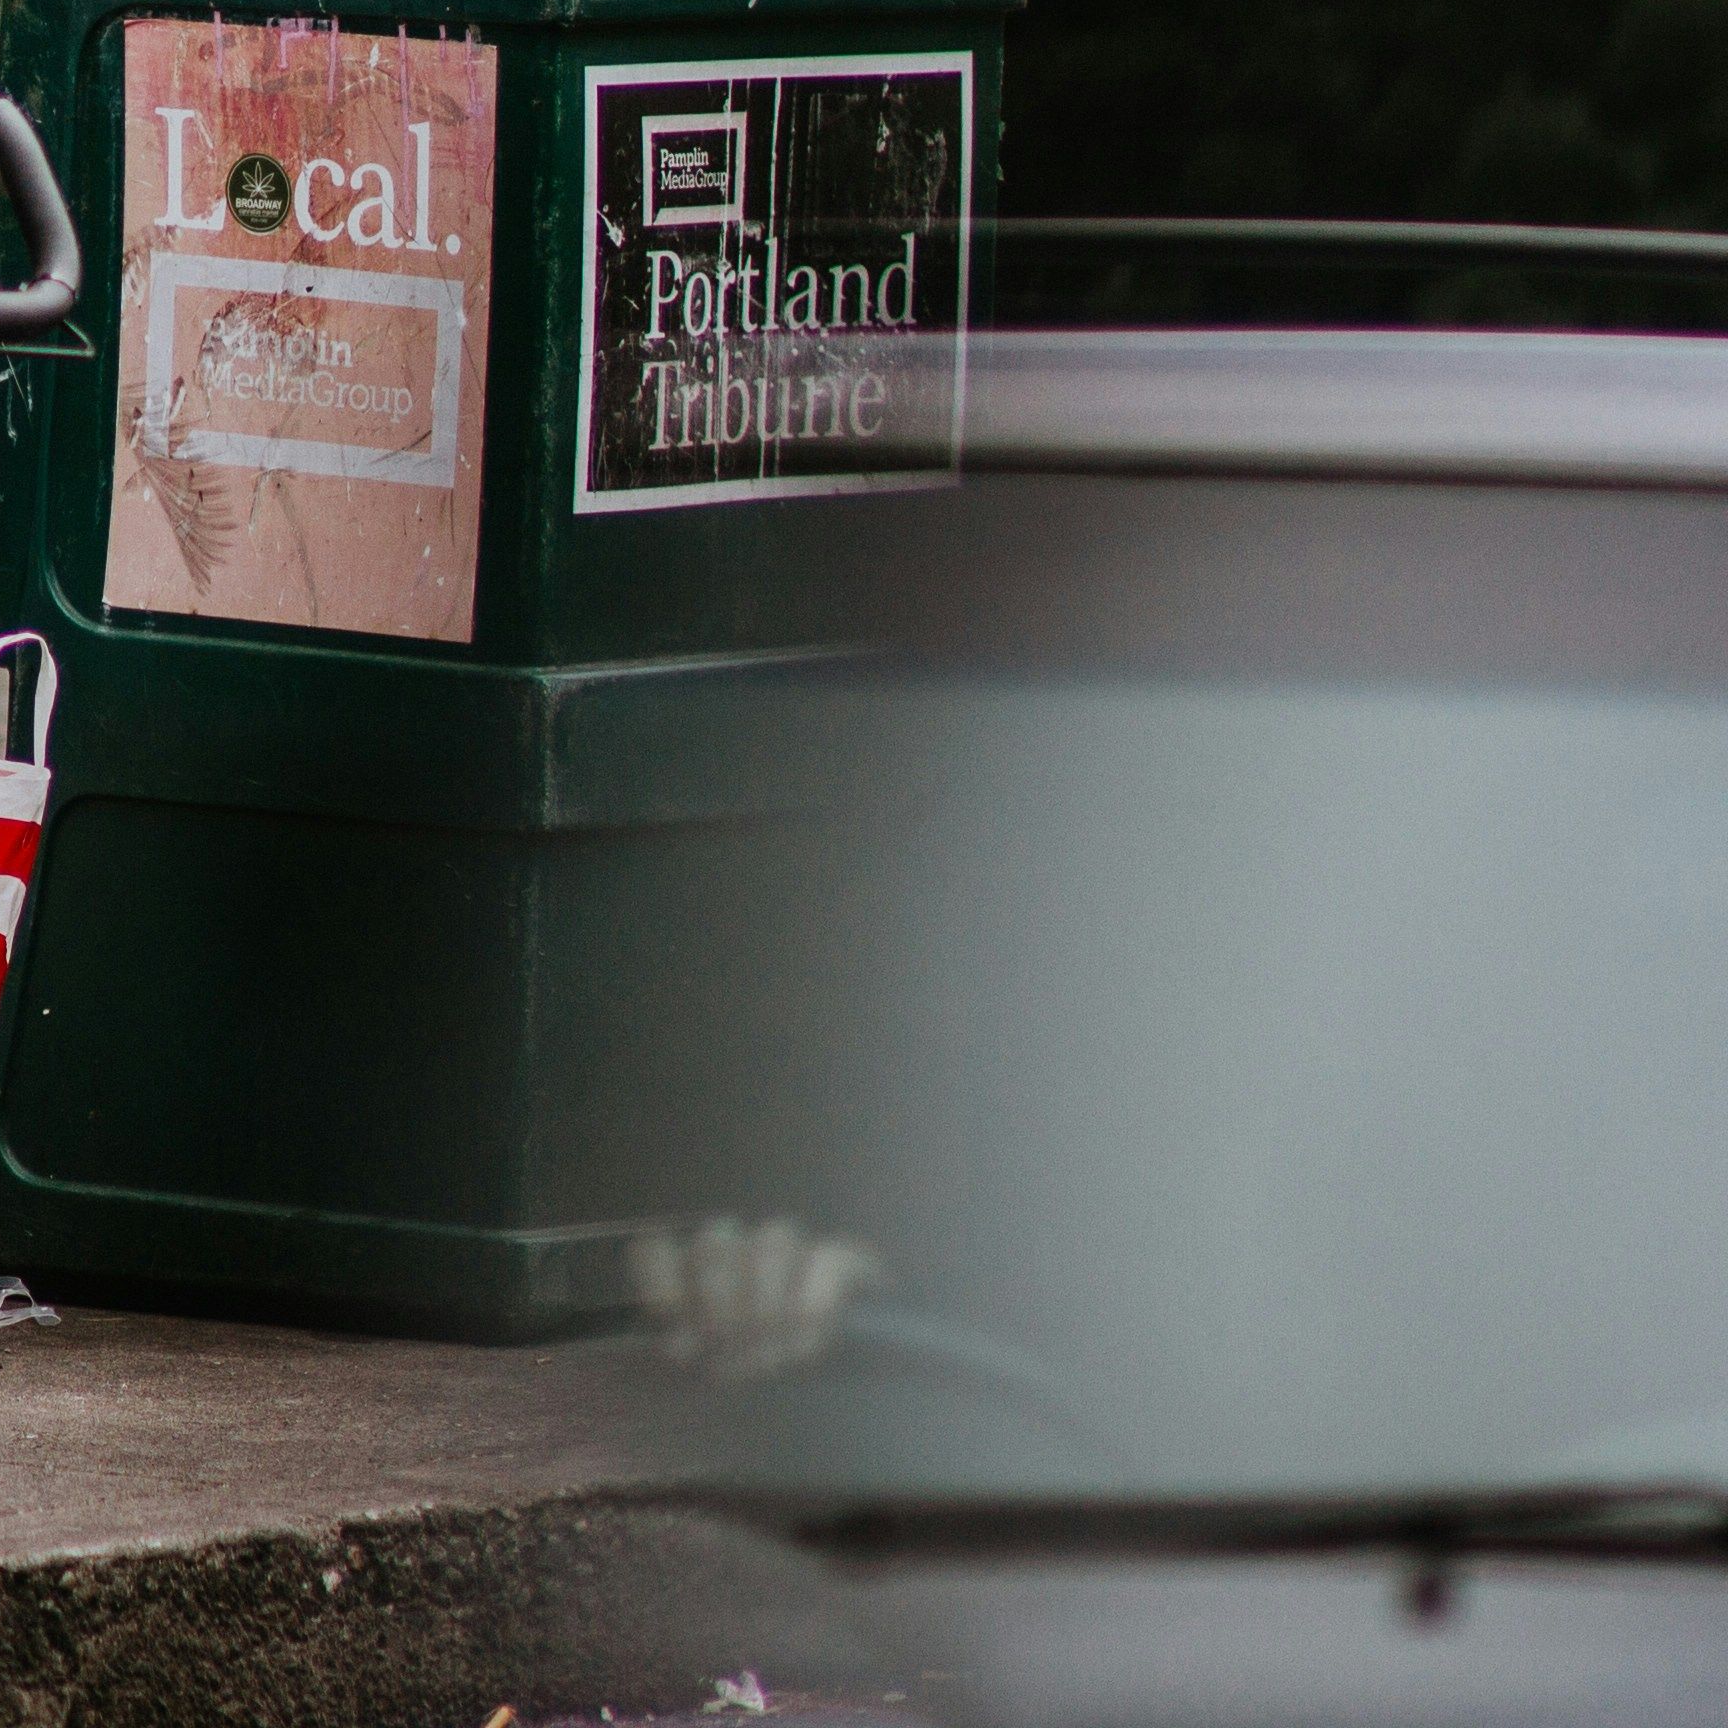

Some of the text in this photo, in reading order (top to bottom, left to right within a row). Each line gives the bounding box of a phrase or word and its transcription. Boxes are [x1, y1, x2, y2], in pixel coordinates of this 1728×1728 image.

[154, 107, 461, 255] Lcal.
[660, 147, 710, 172] Pamplin
[660, 168, 728, 196] MediaGroup
[235, 197, 283, 210] BROADWAY
[644, 232, 917, 340] Portland
[199, 318, 353, 370] Pamplin
[200, 354, 414, 423] MediaGroup
[643, 360, 886, 450] Tribune
